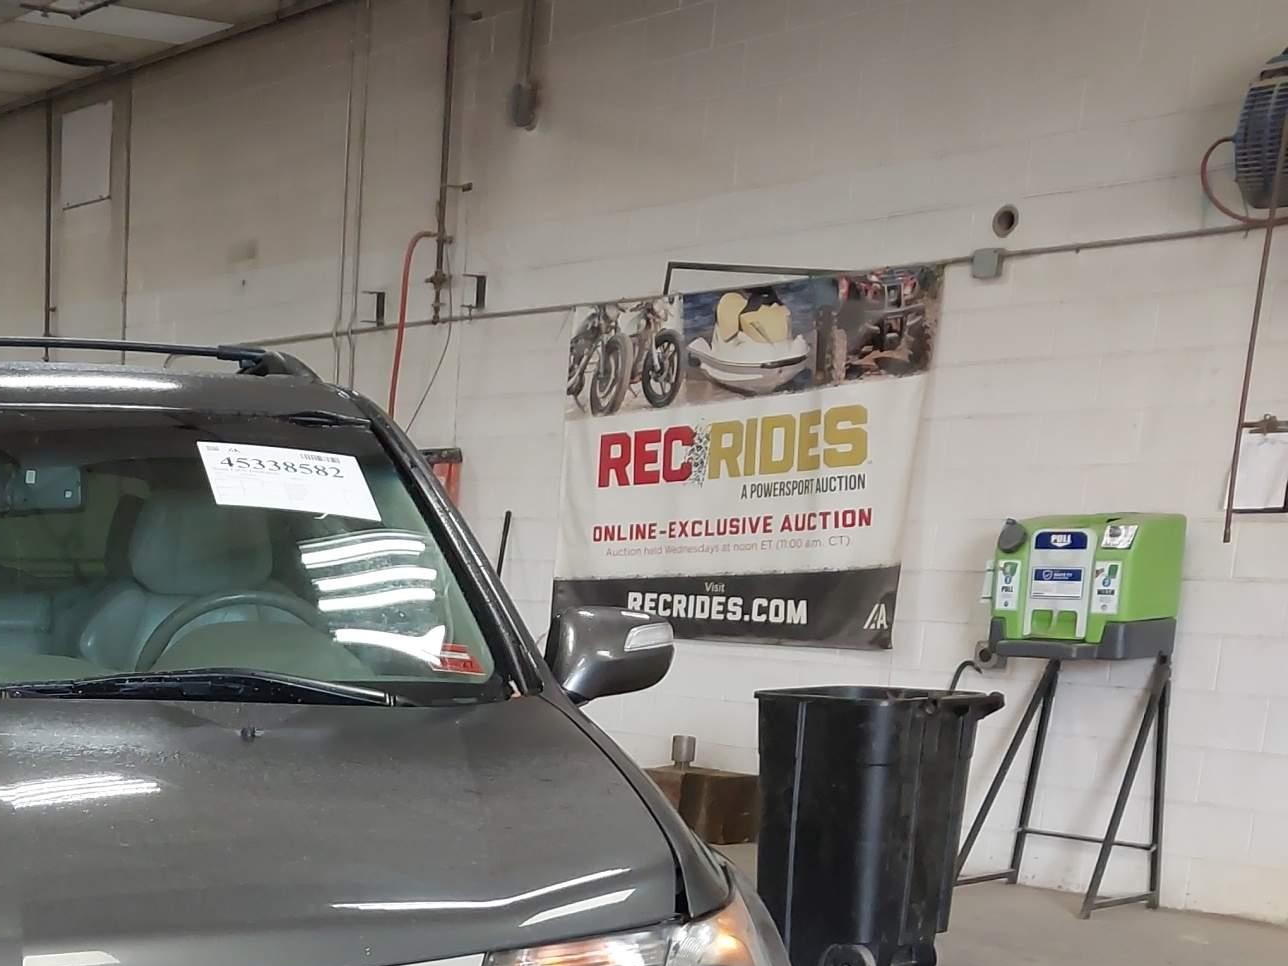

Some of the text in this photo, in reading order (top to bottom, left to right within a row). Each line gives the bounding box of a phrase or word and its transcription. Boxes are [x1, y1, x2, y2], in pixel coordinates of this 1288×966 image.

[598, 404, 868, 488] REC RIDES
[220, 456, 344, 479] 45338582
[741, 474, 866, 499] A POWERSPORT AUCTION
[592, 508, 872, 542] ONLINE-EXCLUSIVE AUCTION
[606, 547, 641, 557] Auction
[644, 544, 663, 555] held
[665, 543, 719, 555] Wednesdays
[721, 543, 731, 552] at
[733, 542, 758, 551] noon
[760, 540, 773, 550] ET
[828, 535, 851, 547] CT)
[704, 582, 725, 593] Visit
[627, 591, 808, 625] RECRIDES.COM
